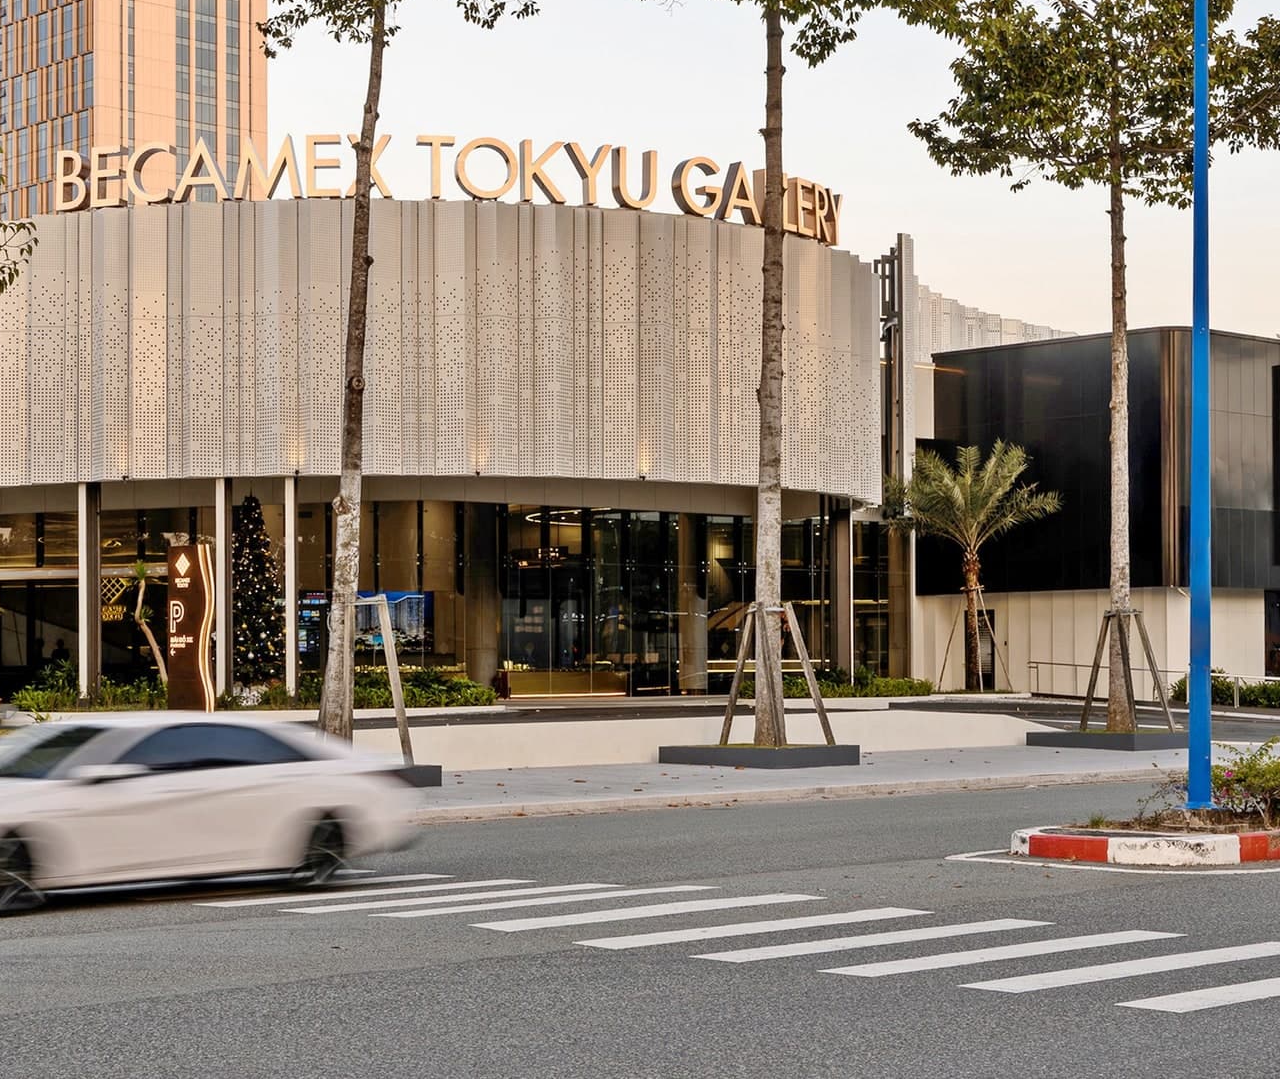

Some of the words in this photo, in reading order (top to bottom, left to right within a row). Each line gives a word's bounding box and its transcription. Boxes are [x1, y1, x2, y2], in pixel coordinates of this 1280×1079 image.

[56, 134, 394, 214] BECAMEX
[416, 135, 658, 209] TOKYU
[672, 156, 843, 246] GALERY
[170, 601, 184, 633] P
